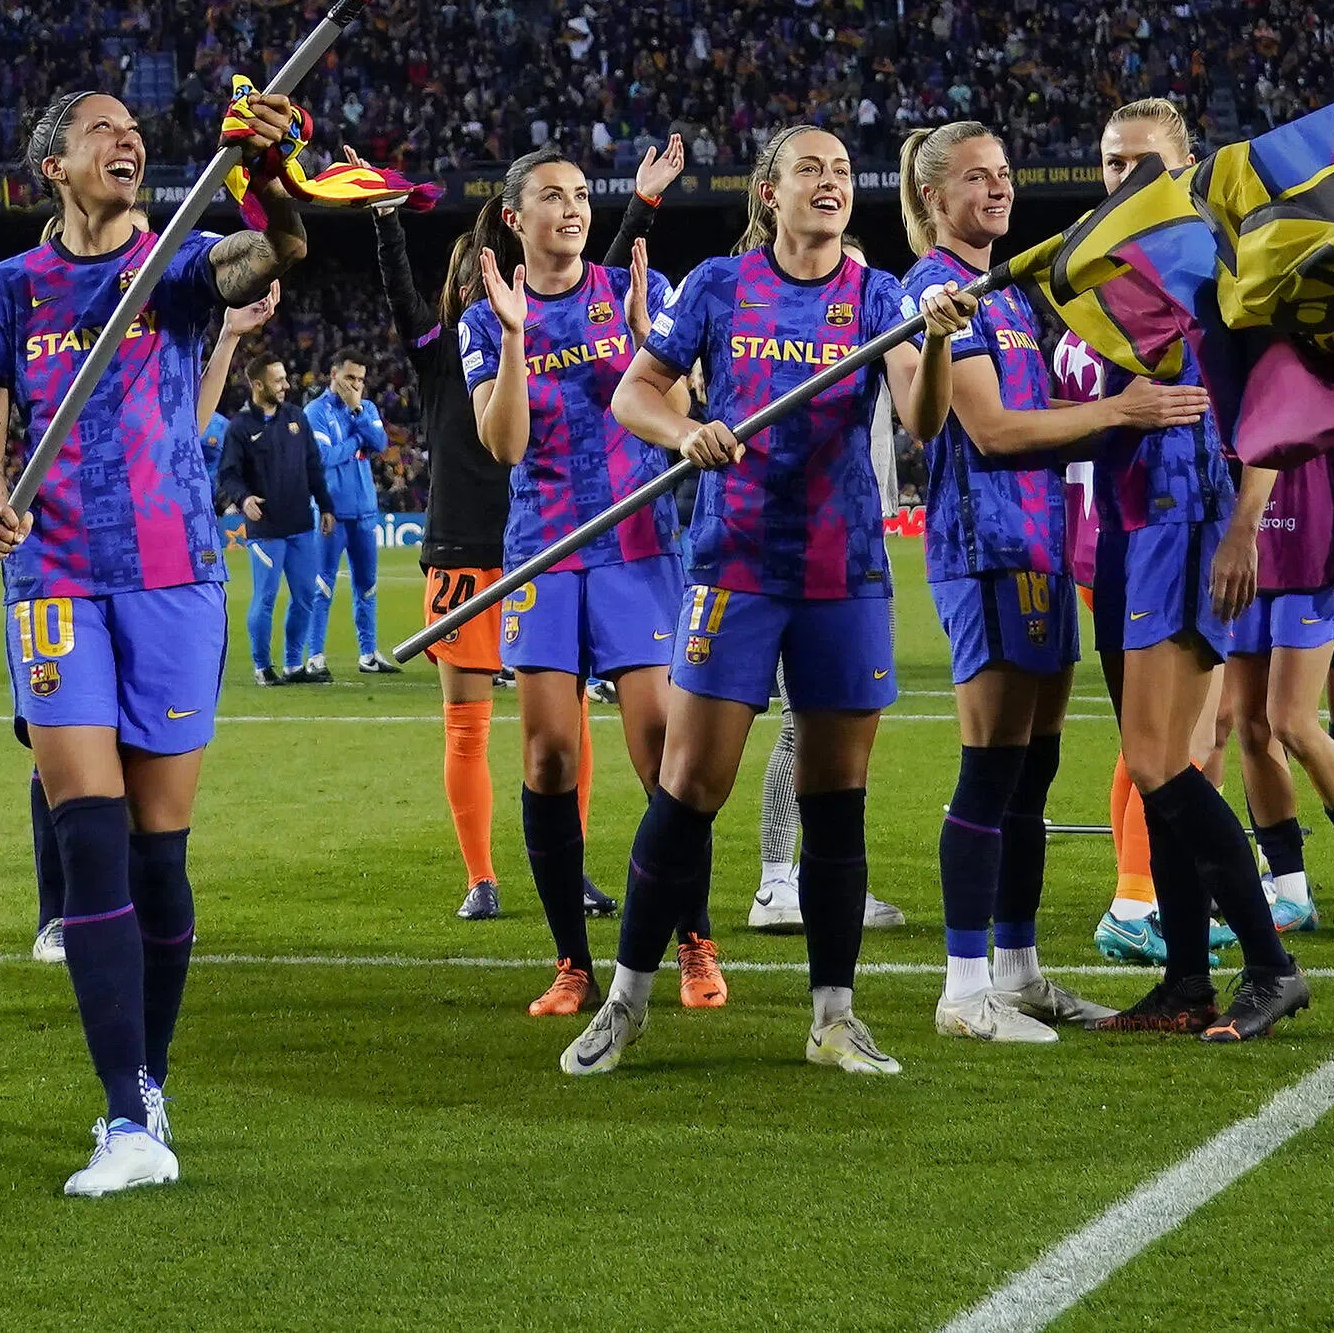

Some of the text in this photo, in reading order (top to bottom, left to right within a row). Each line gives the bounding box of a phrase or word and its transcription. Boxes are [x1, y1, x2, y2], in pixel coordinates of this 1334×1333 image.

[1049, 167, 1070, 183] UN
[27, 310, 156, 361] STANEY
[732, 335, 860, 366] STANLEY
[14, 597, 76, 663] 10
[689, 585, 732, 635] 11
